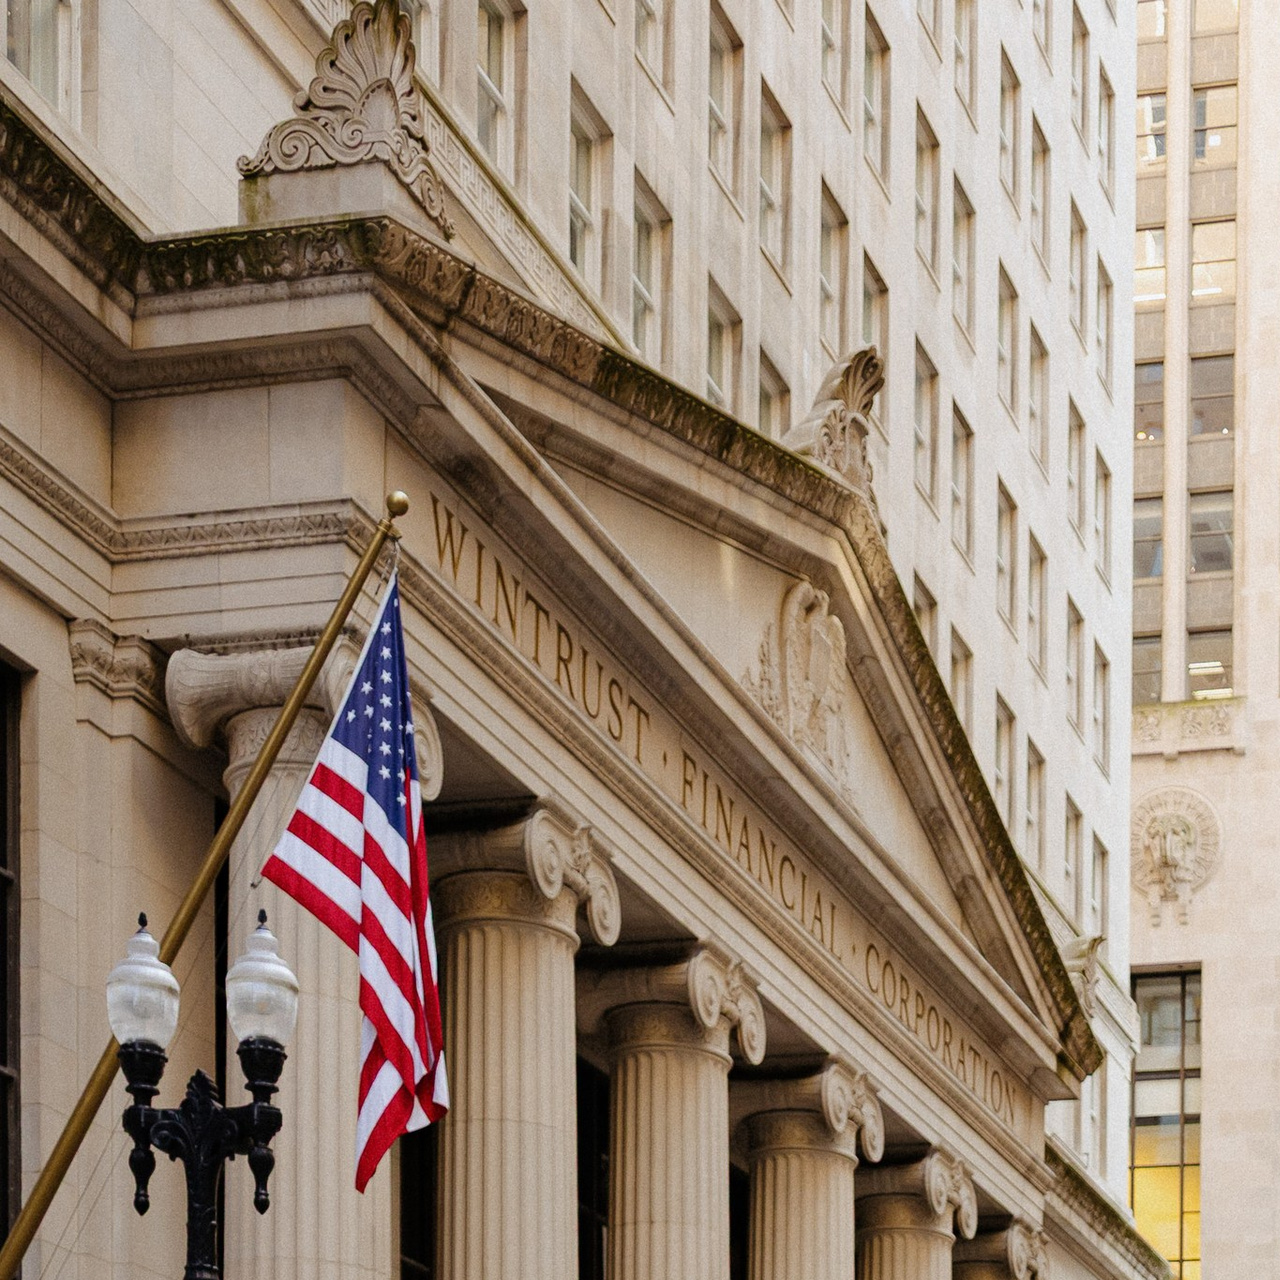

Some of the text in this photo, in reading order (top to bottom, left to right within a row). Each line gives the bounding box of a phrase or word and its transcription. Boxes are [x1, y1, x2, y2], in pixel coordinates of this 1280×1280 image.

[430, 491, 1017, 1126] WINTRUST FINANCIAL CORPORATION
